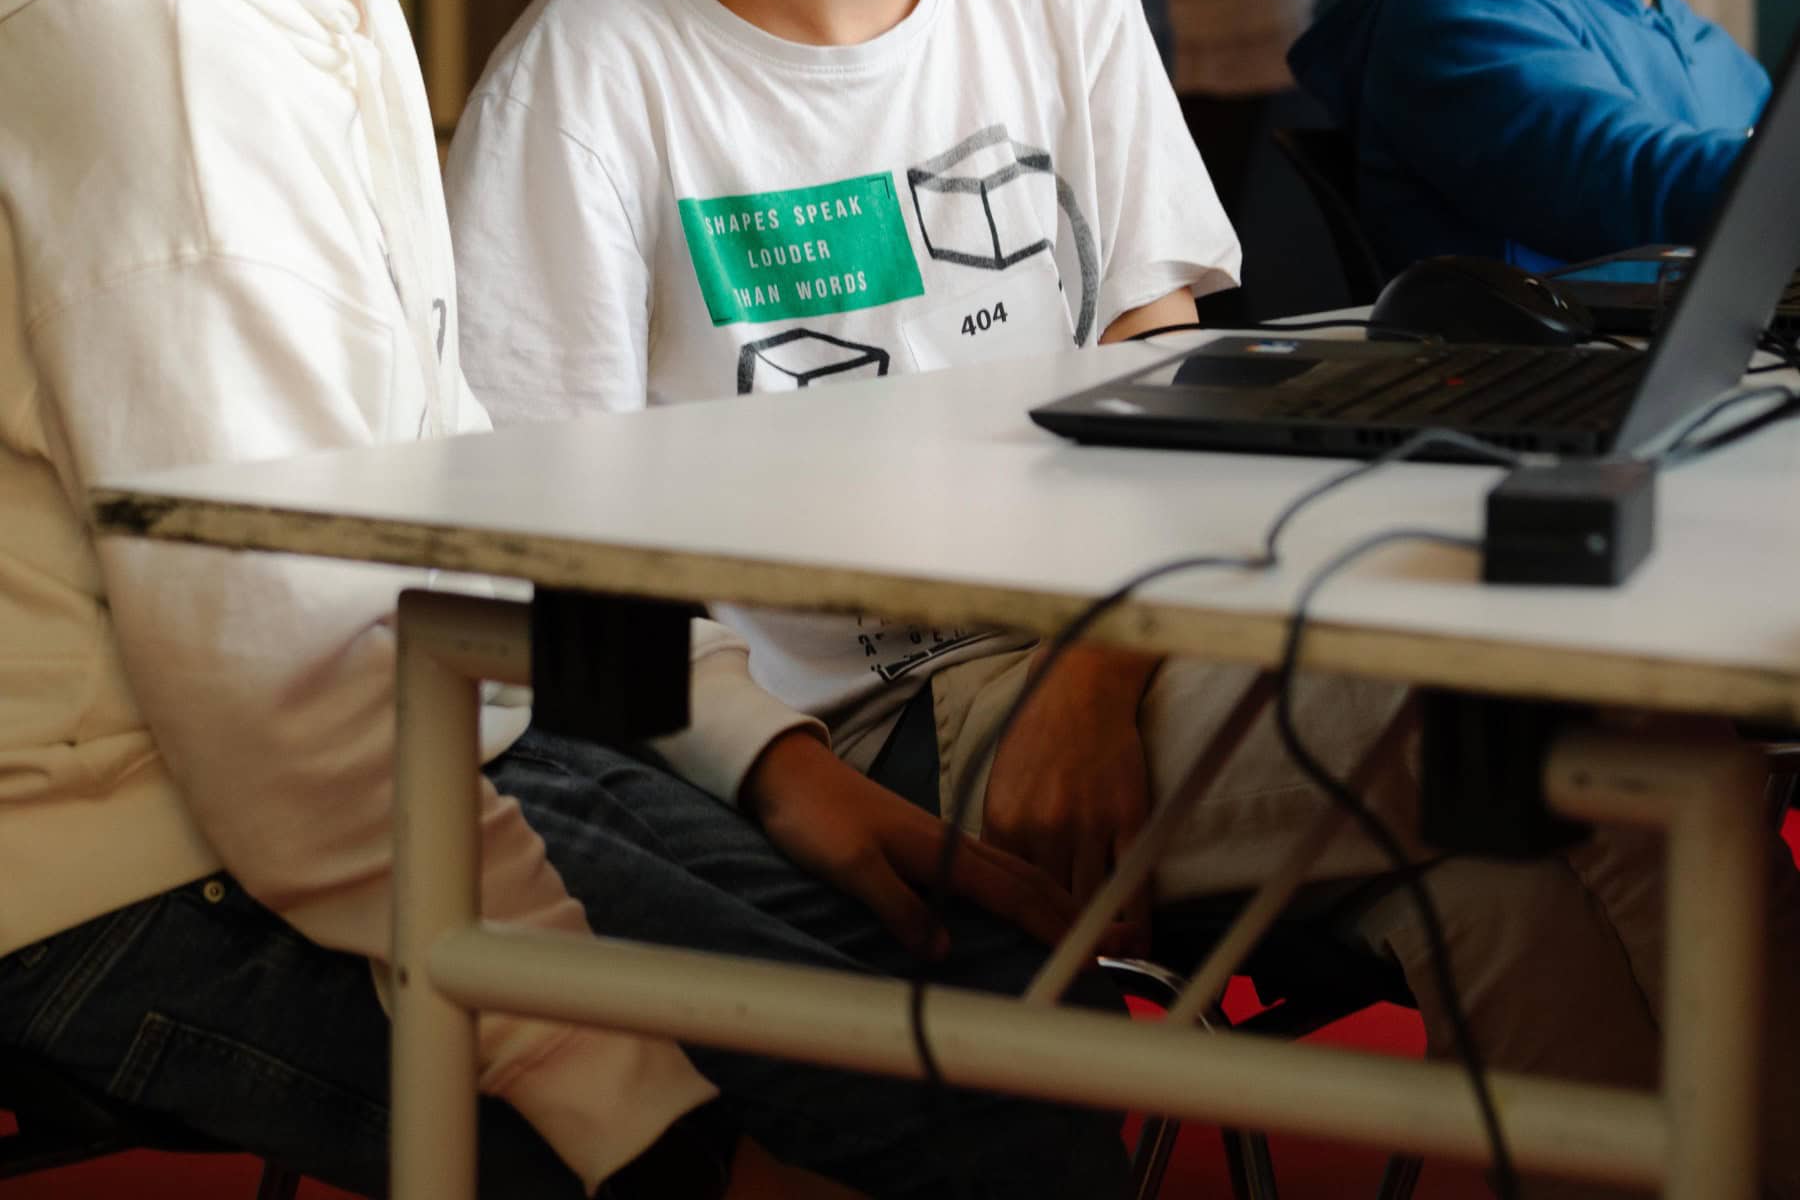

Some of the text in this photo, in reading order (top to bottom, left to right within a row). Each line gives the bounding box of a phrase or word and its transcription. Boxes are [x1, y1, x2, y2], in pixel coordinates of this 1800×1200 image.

[704, 195, 862, 236] SHAPES SPEAK
[748, 240, 831, 268] LOUDER
[795, 271, 867, 300] WORDS
[961, 301, 1008, 336] 404
